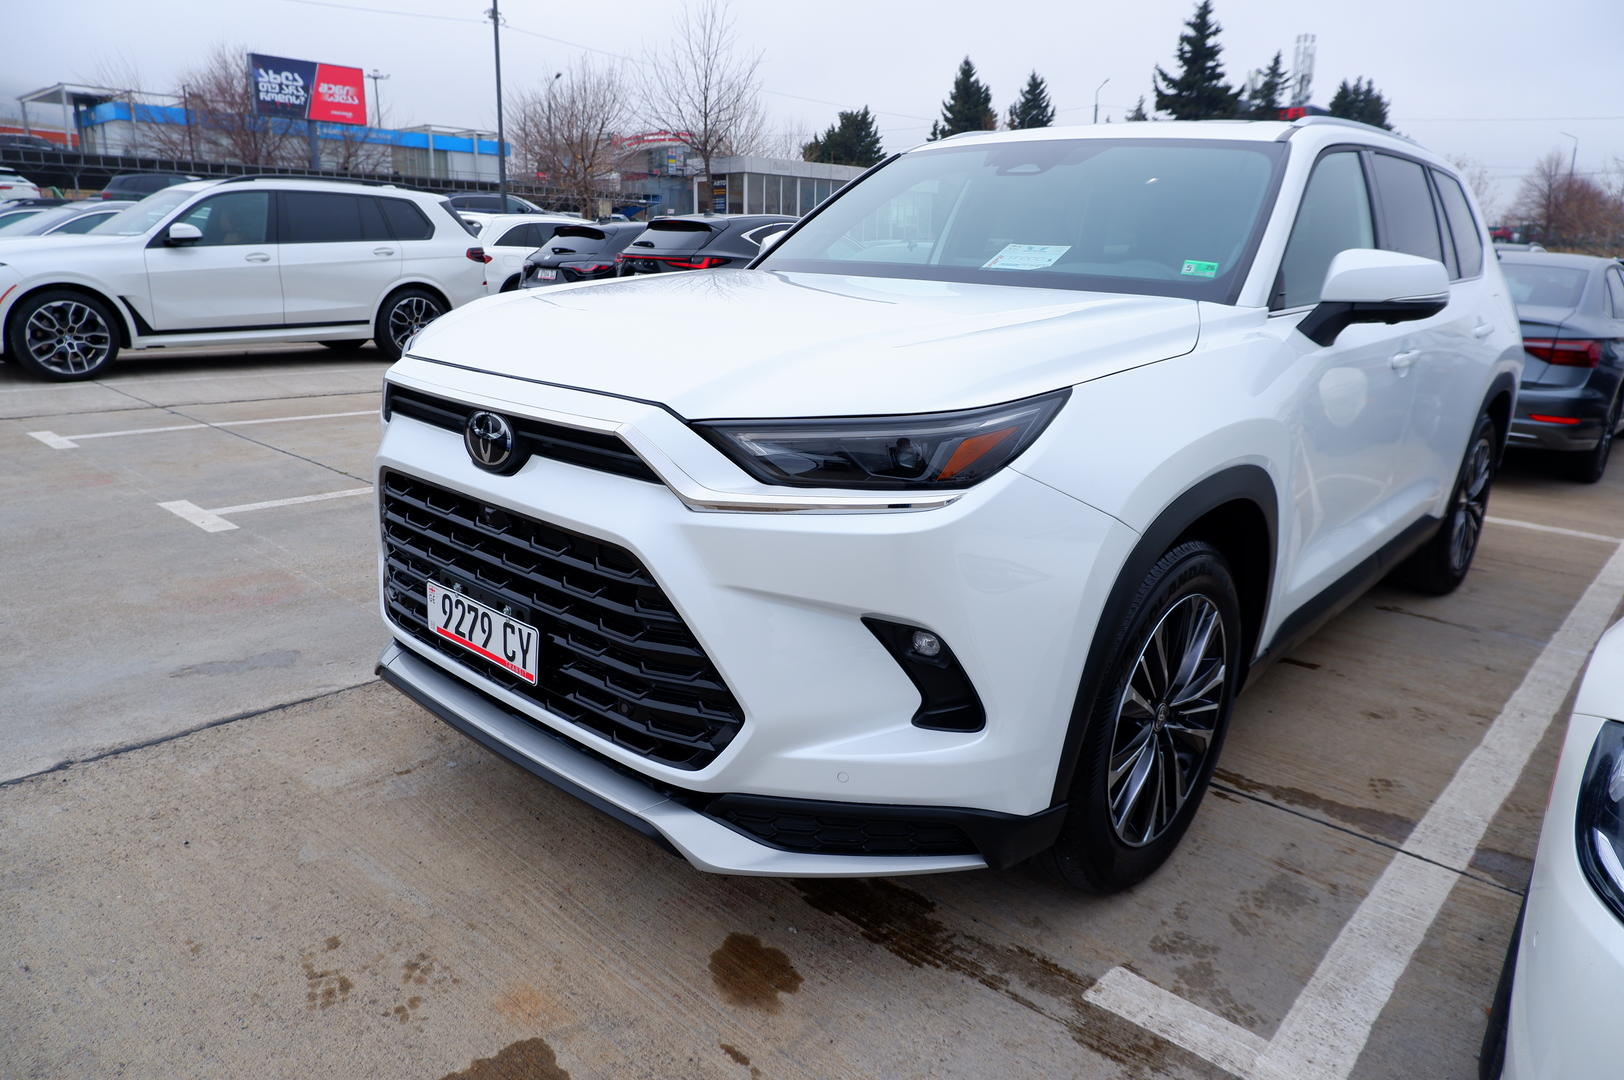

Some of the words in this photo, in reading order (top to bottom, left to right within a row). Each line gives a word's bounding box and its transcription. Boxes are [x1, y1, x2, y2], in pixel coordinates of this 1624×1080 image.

[258, 69, 303, 86] ახლა
[259, 83, 280, 92] თუ
[441, 593, 493, 649] 9279
[503, 621, 532, 670] CY
